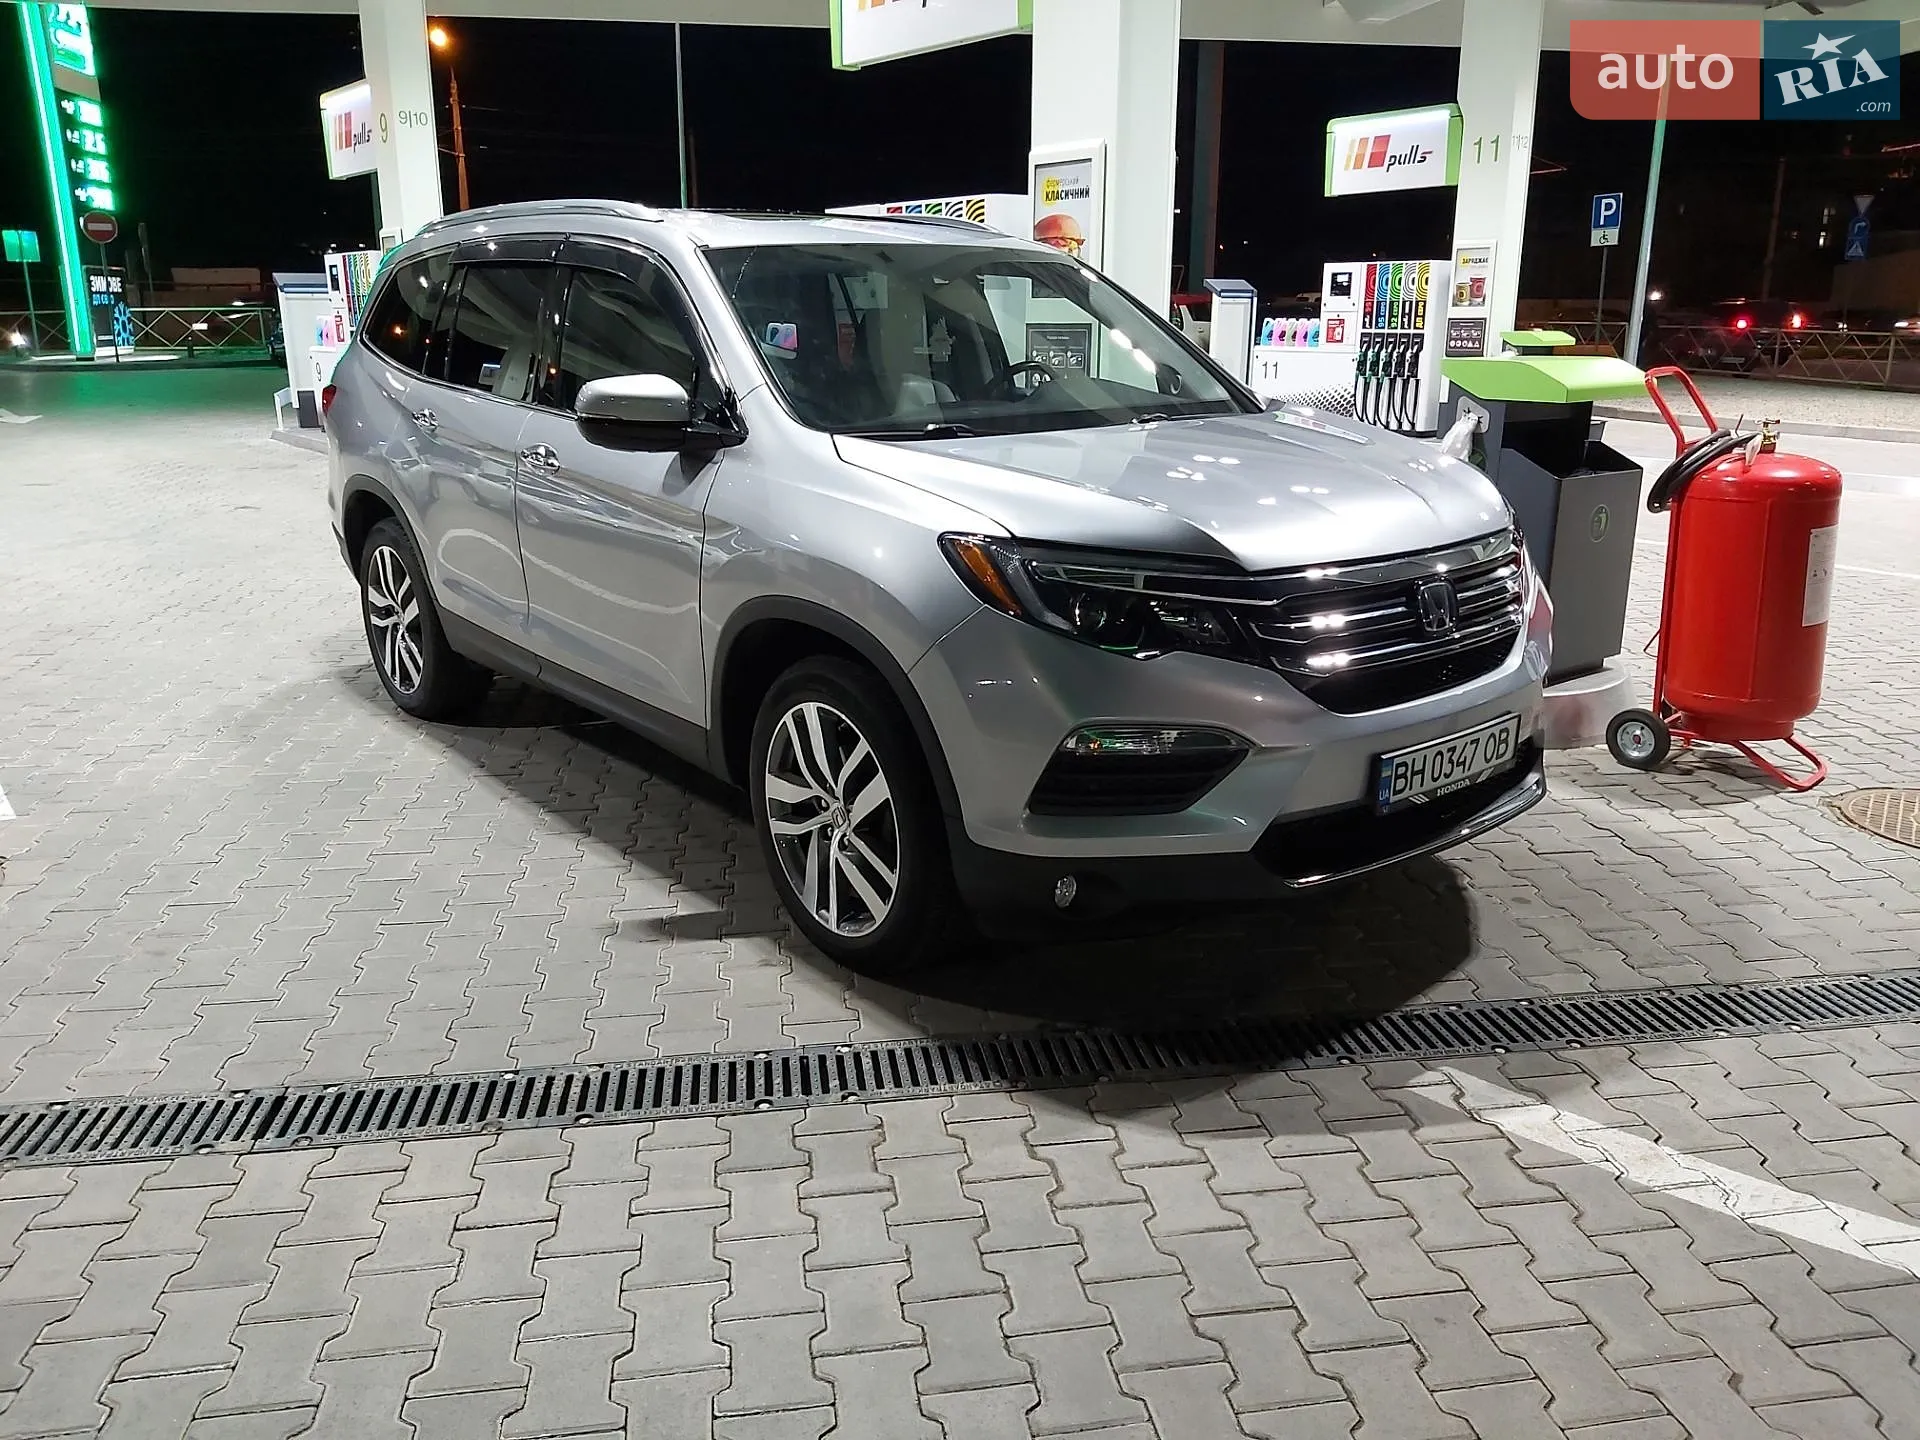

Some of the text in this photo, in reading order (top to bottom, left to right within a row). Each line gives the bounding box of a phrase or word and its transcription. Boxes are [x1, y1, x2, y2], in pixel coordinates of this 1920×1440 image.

[353, 121, 372, 152] pulls
[380, 112, 388, 143] 9
[1386, 144, 1433, 172] pulls
[1473, 134, 1500, 163] 11
[1045, 185, 1090, 202] КЛАСИЧНИЙ
[1599, 198, 1617, 225] P
[1391, 317, 1397, 327] 92
[316, 362, 322, 382] 9
[1262, 361, 1278, 379] 11
[1392, 727, 1510, 796] BH 0347 OB
[1379, 789, 1390, 801] UA
[1437, 779, 1471, 797] HONDA
